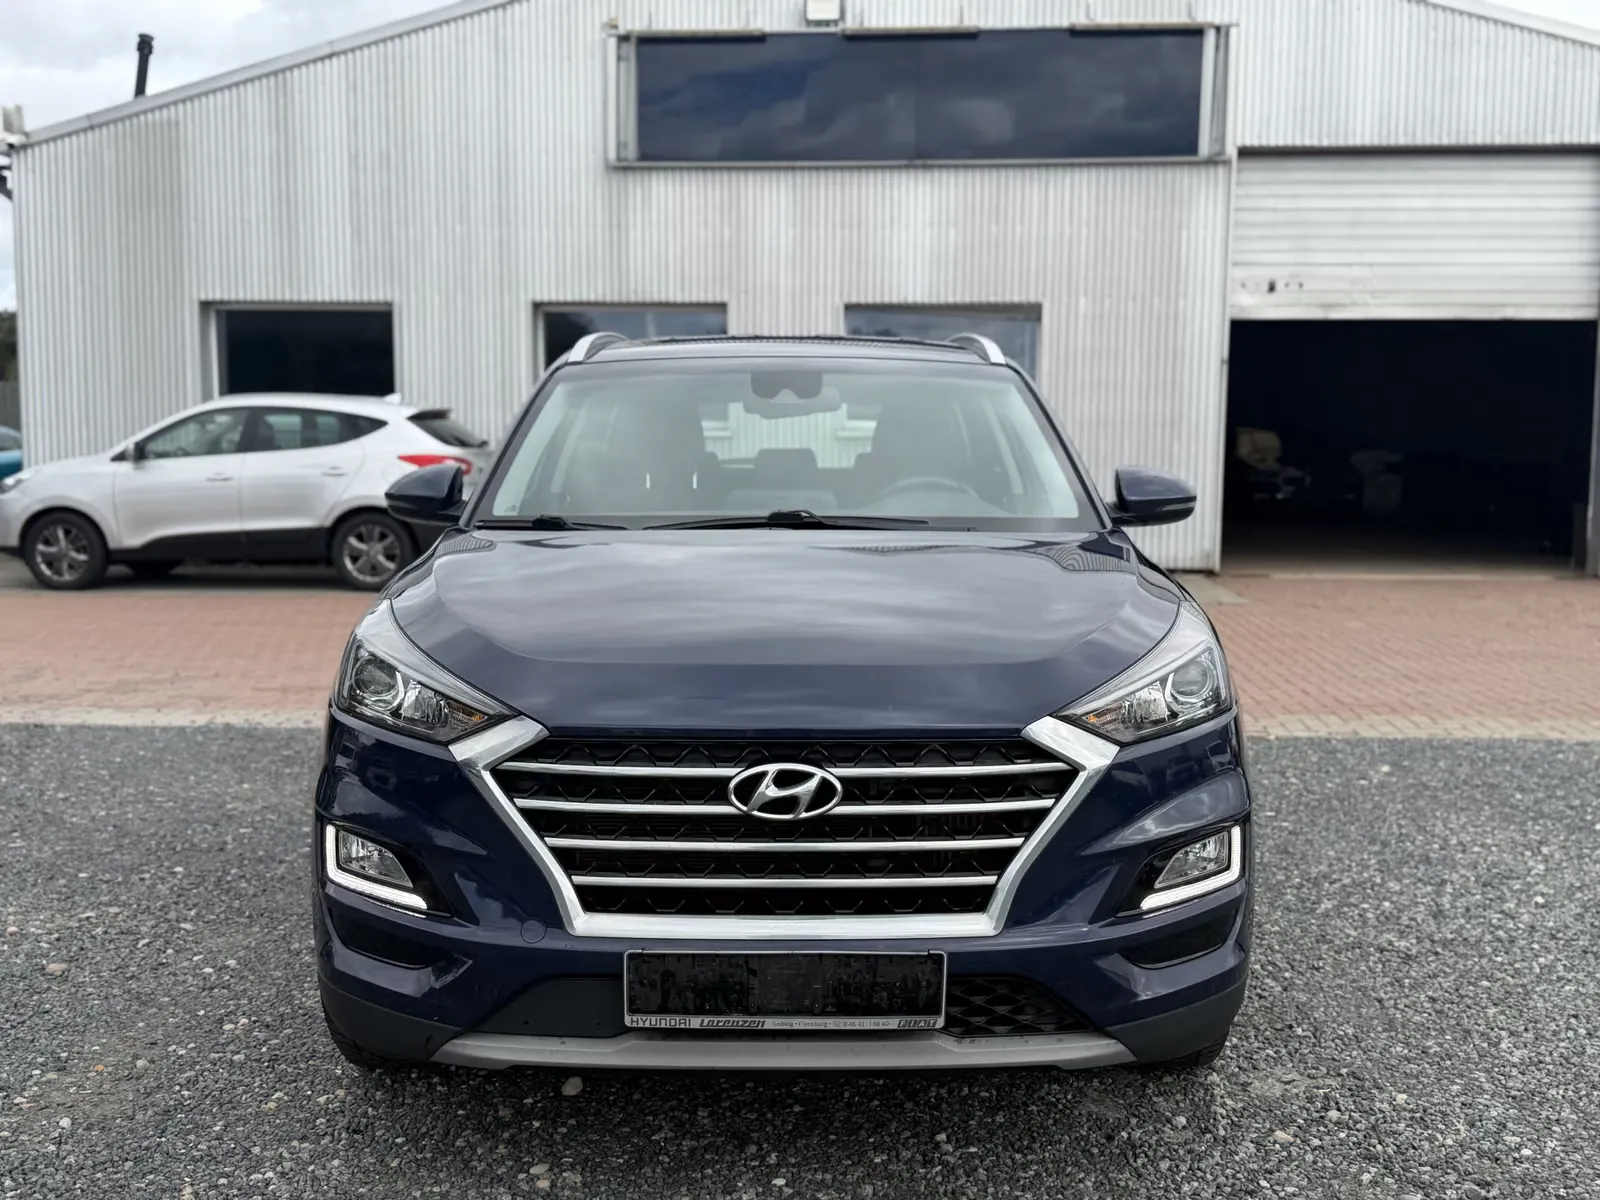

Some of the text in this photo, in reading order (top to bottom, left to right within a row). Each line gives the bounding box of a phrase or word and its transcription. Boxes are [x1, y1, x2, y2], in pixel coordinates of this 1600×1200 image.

[630, 1017, 691, 1028] HYUNDAI
[699, 1018, 766, 1028] Lorenzen
[898, 1019, 937, 1027] FIAT
